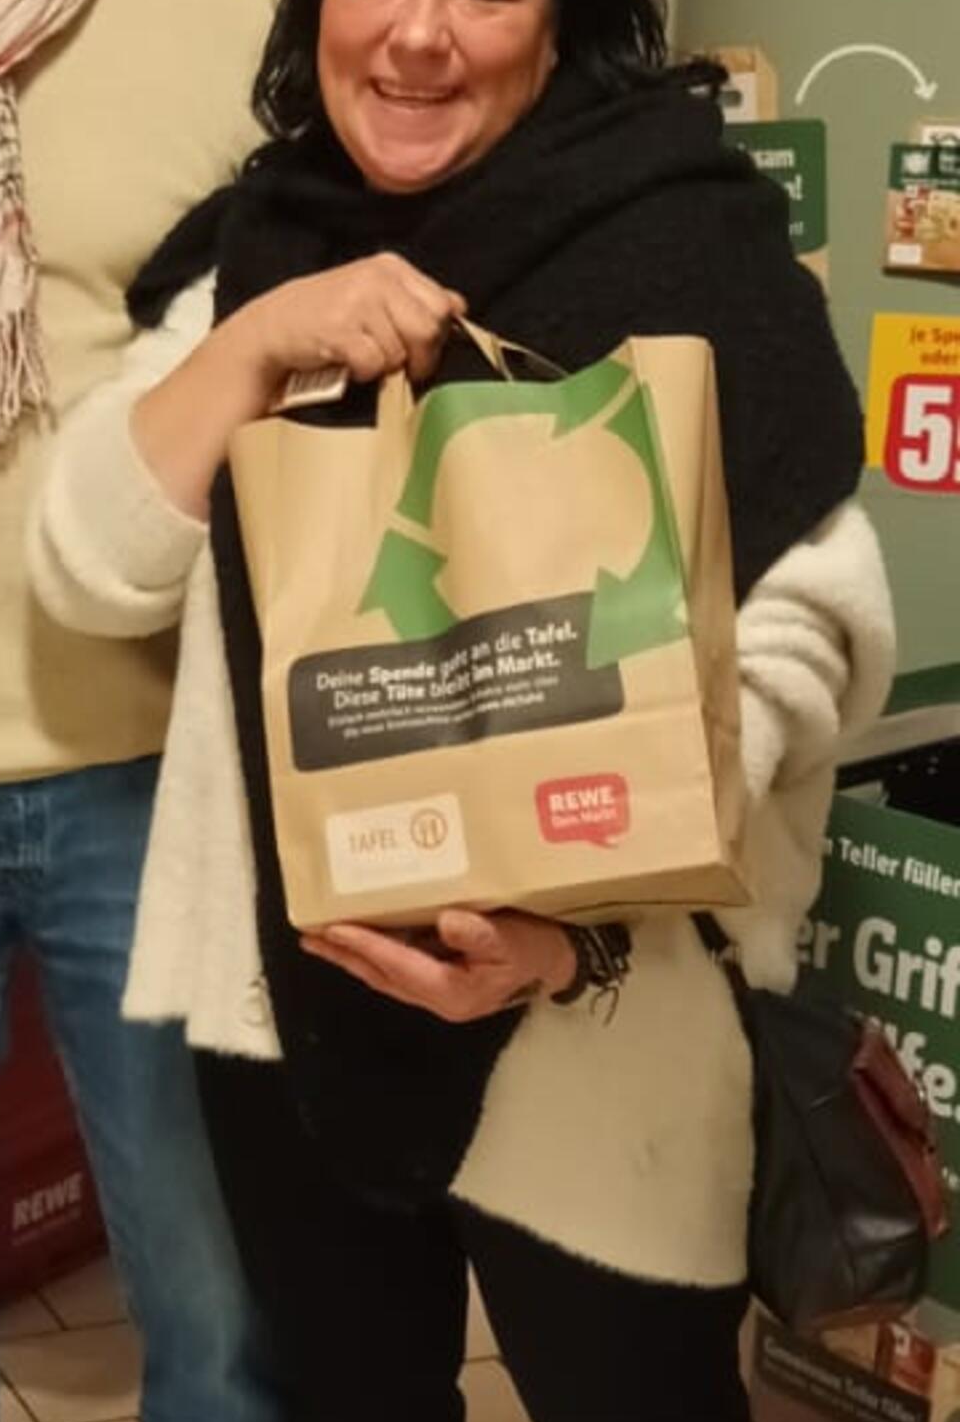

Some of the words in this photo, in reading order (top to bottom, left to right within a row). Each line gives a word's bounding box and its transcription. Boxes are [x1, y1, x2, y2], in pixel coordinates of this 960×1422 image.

[898, 383, 960, 483] 5
[316, 671, 364, 692] Deine
[369, 665, 436, 687] Spende
[495, 632, 522, 653] die
[524, 621, 578, 646] Tafel.
[333, 690, 380, 710] Diese
[386, 683, 425, 701] Tüte
[496, 650, 562, 676] Markt.
[548, 785, 615, 813] REWE
[347, 827, 398, 855] TAFEL
[839, 836, 899, 877] Teller
[13, 1171, 83, 1231] REWE
